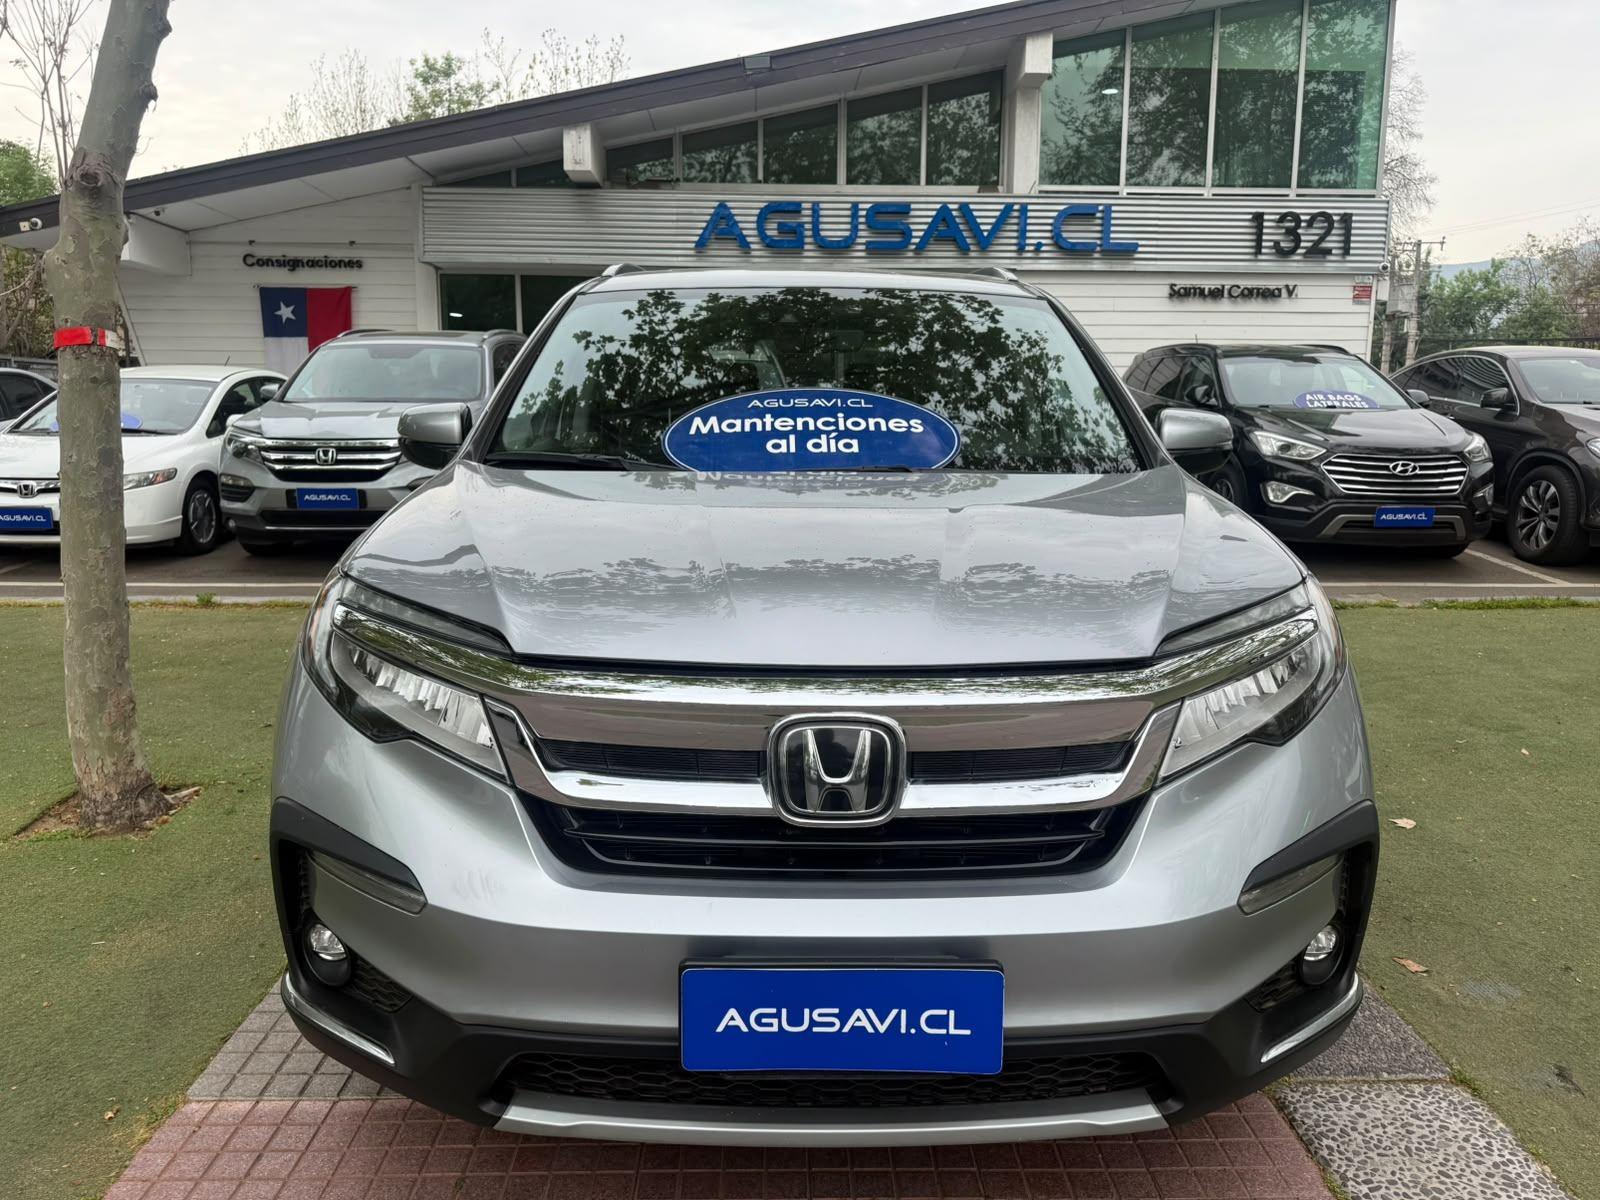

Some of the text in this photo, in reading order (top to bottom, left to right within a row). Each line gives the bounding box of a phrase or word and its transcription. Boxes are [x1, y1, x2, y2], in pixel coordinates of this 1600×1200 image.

[695, 201, 1139, 254] AGUSAVI.CL
[1251, 211, 1353, 257] 1321
[242, 253, 363, 272] Consignaciones
[1168, 283, 1299, 299] Samuel Correa V.
[747, 398, 873, 408] AGUSAVI.CL
[1305, 393, 1326, 401] AIR
[688, 413, 924, 435] Mantenciones
[765, 432, 859, 454] al día
[1380, 511, 1428, 520] AGUSAVI.CL
[715, 1007, 972, 1035] AGUSAVI.CL
